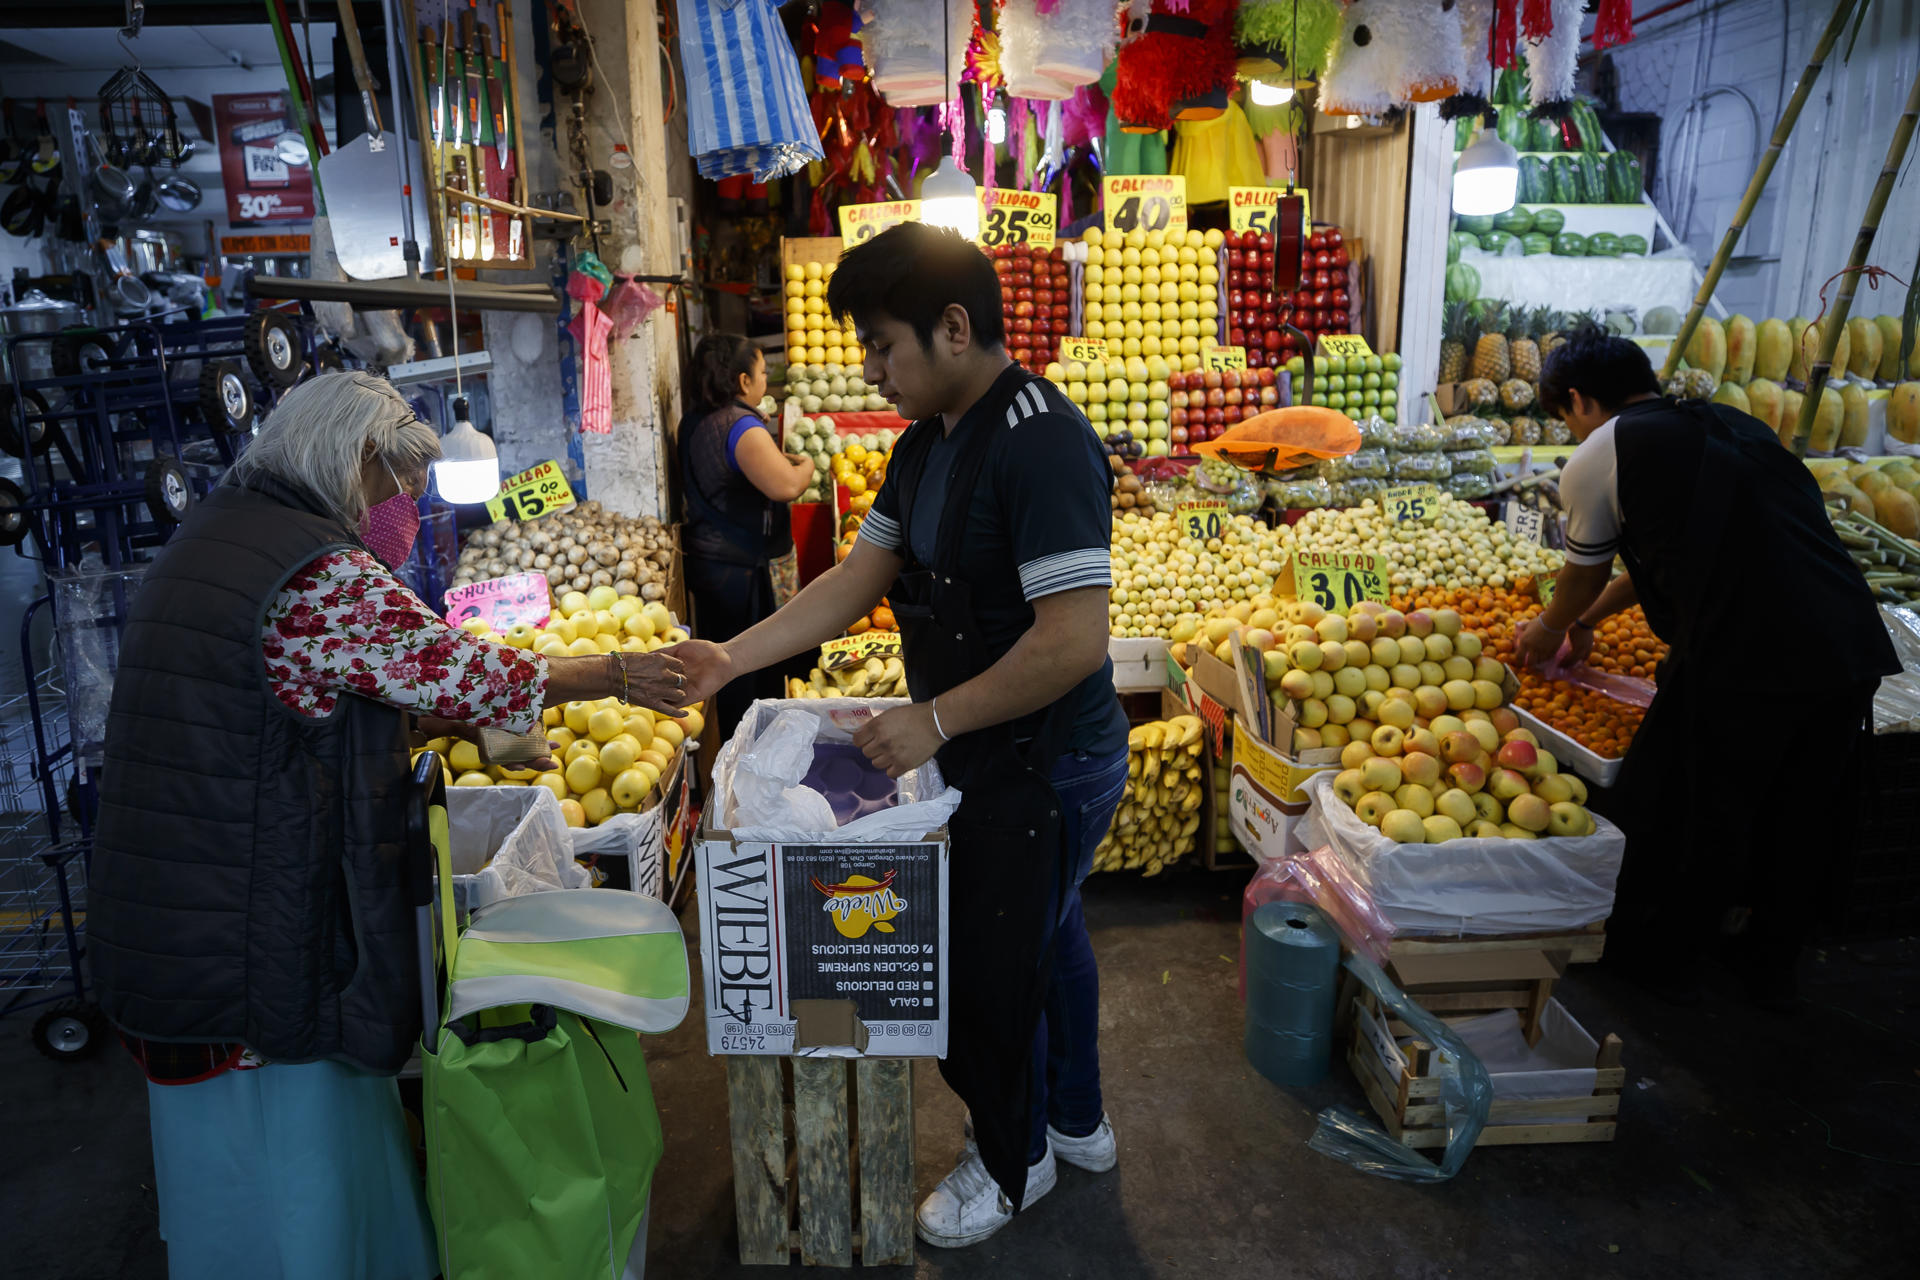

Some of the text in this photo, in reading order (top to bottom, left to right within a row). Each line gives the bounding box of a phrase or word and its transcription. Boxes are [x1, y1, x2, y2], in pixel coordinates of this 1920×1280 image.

[1110, 178, 1174, 194] CALIDAD
[848, 203, 913, 223] CALIDAD
[1113, 196, 1170, 233] 40
[497, 464, 552, 497] ALIDAD
[1396, 498, 1426, 523] 25
[1189, 512, 1221, 539] 30
[1298, 552, 1376, 571] CALIDAD
[852, 708, 868, 717] 100
[822, 887, 908, 922] Wiebe
[711, 849, 774, 1011] WIEBE
[811, 944, 920, 955] GOLDEN DELICIOUS
[817, 962, 920, 973] GOLDEN SUPREME
[835, 981, 920, 991] RED DELICIOUS
[889, 997, 920, 1007] GALA
[721, 1035, 766, 1051] 24579
